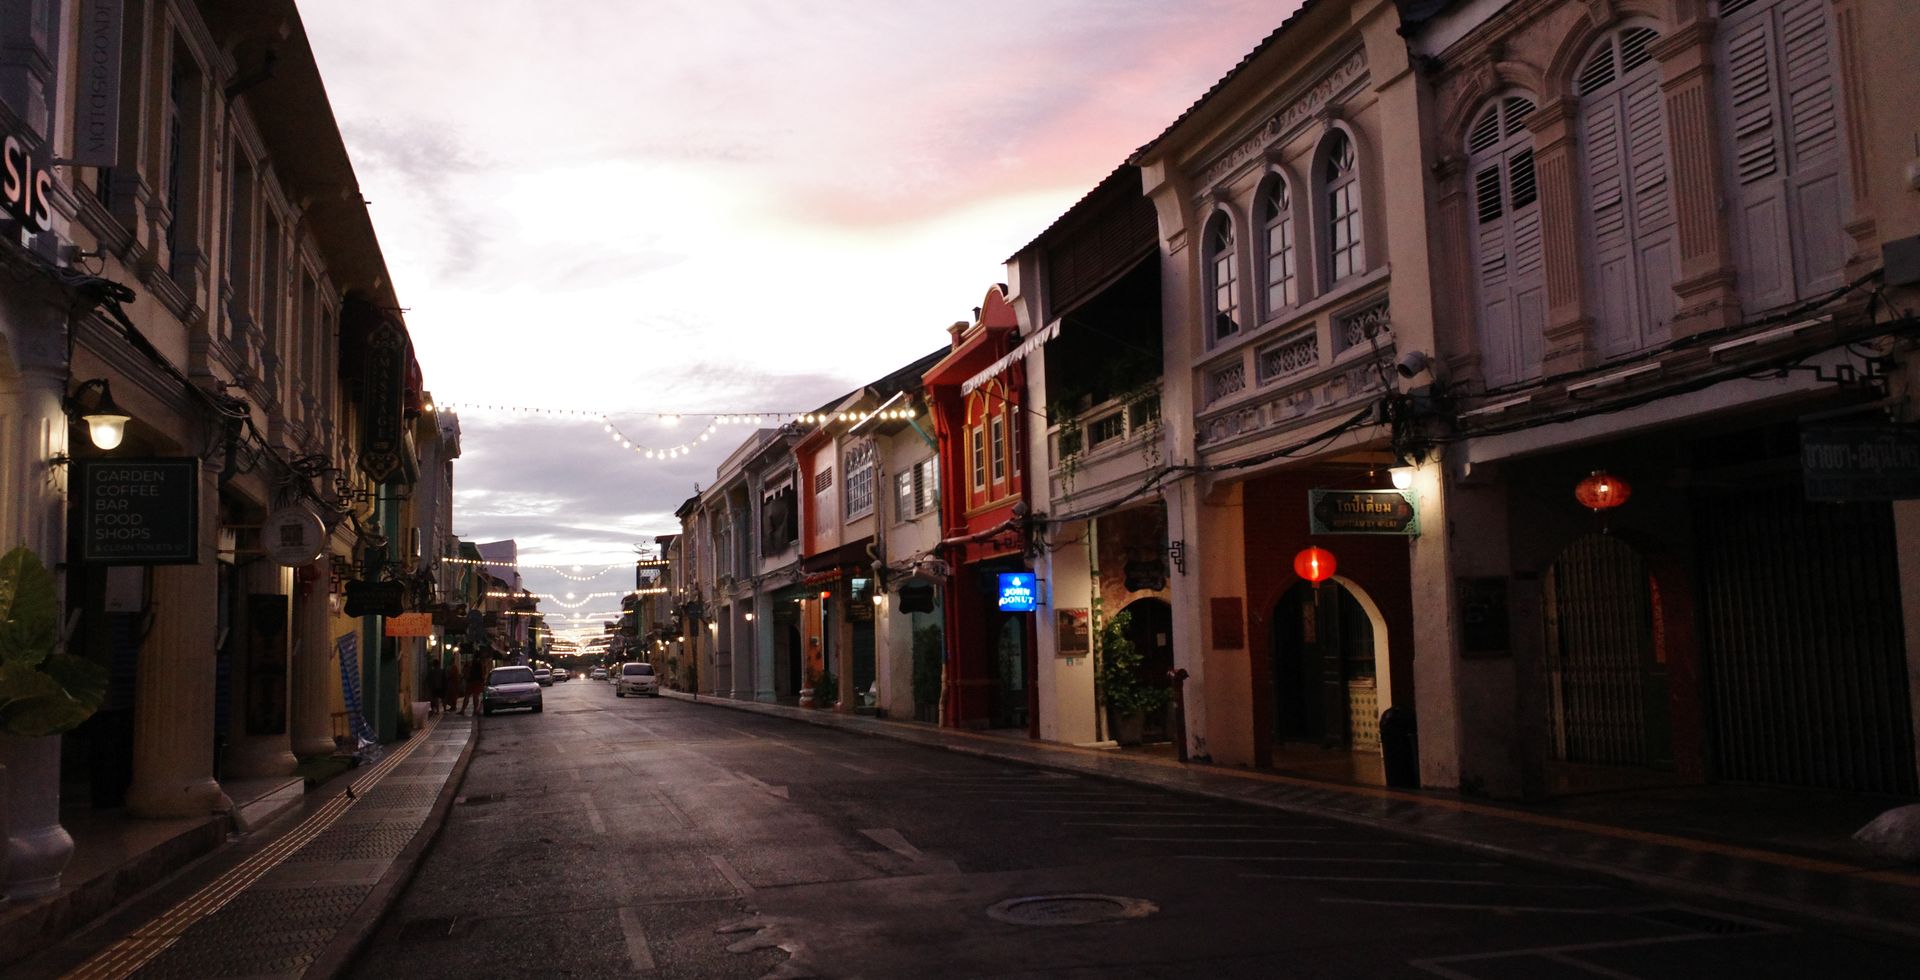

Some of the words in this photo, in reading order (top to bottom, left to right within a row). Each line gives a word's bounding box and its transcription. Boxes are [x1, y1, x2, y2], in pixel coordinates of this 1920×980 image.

[95, 470, 165, 482] GARDEN
[95, 484, 160, 497] COFFEE
[95, 499, 129, 511] BAR
[95, 513, 143, 526] FOOD
[95, 527, 151, 540] SHOPS
[1003, 587, 1031, 596] JOHN
[999, 596, 1034, 606] DONUT
